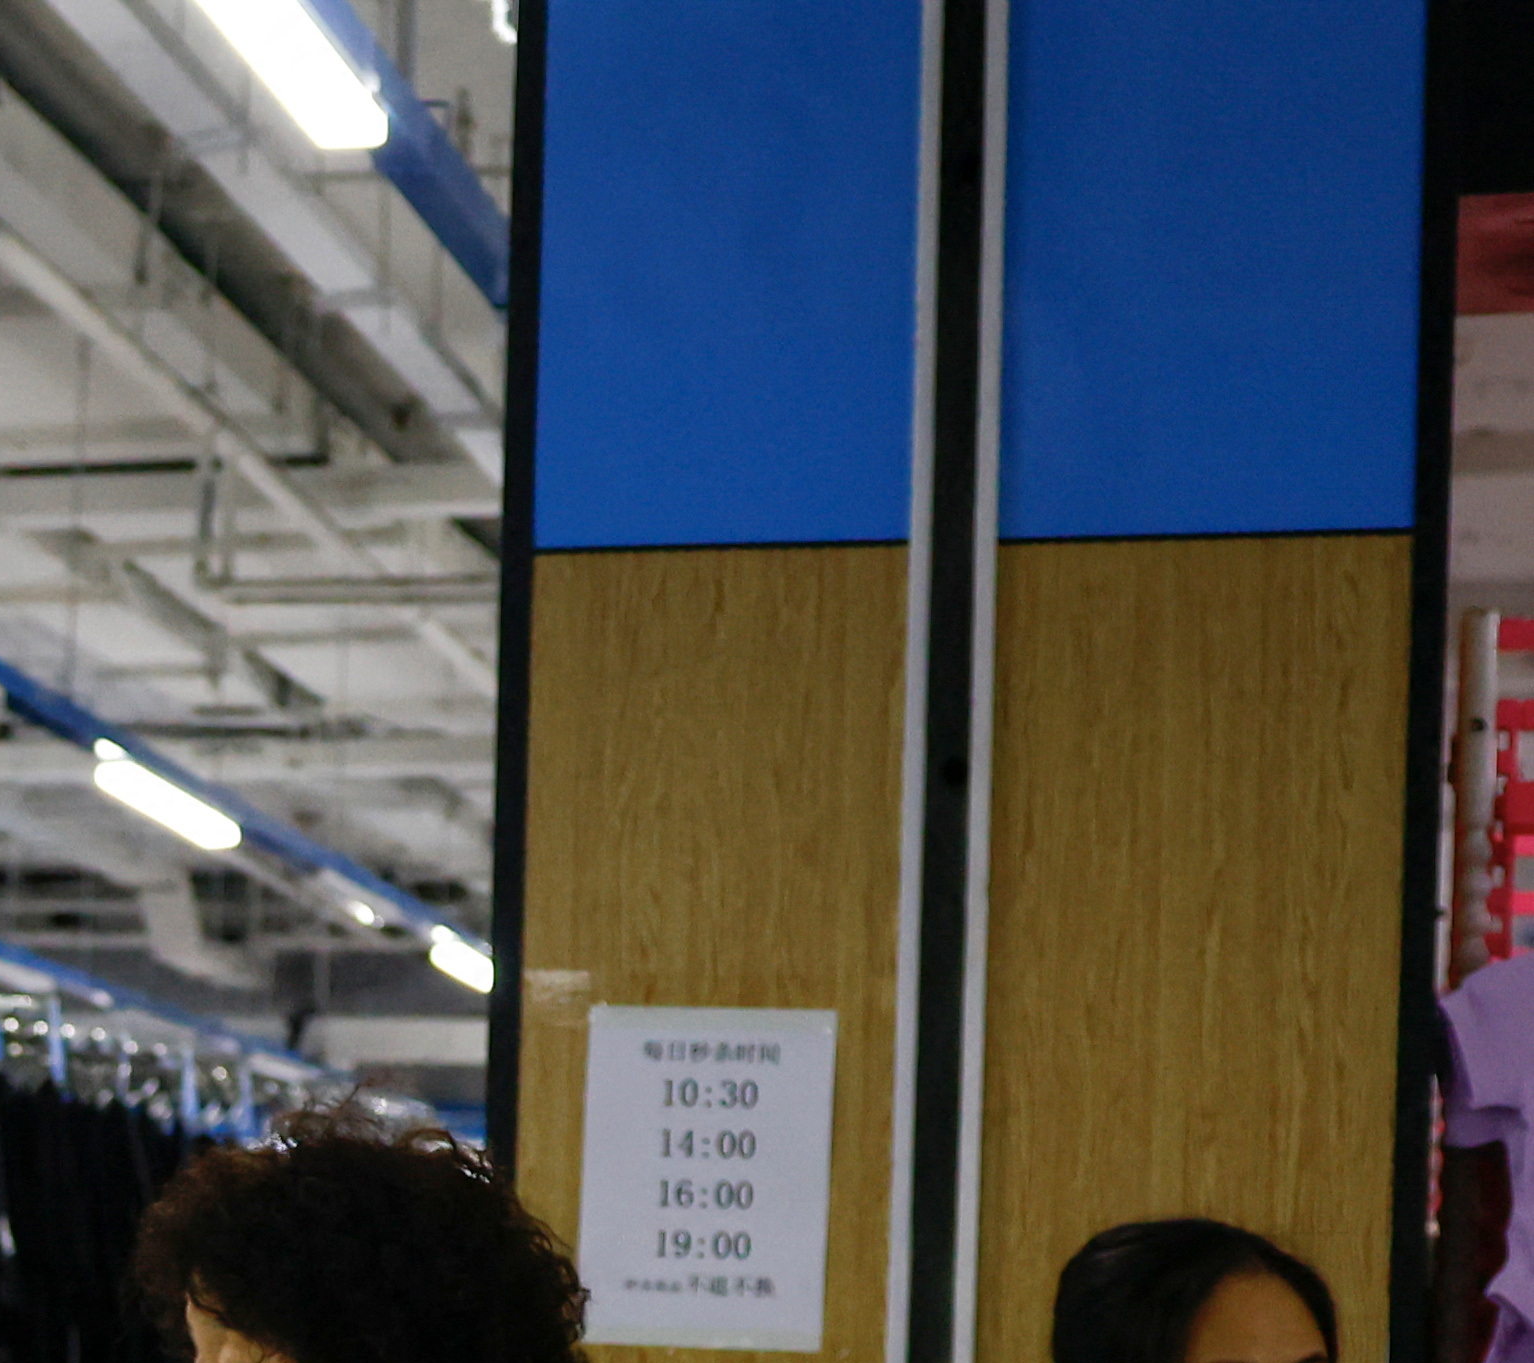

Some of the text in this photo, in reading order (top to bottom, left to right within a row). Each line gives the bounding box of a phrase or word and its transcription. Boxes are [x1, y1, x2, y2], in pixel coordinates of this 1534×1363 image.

[662, 1078, 759, 1109] 10:30
[661, 1128, 757, 1159] 14:00
[658, 1179, 754, 1209] 16:00
[656, 1230, 751, 1260] 19:00
